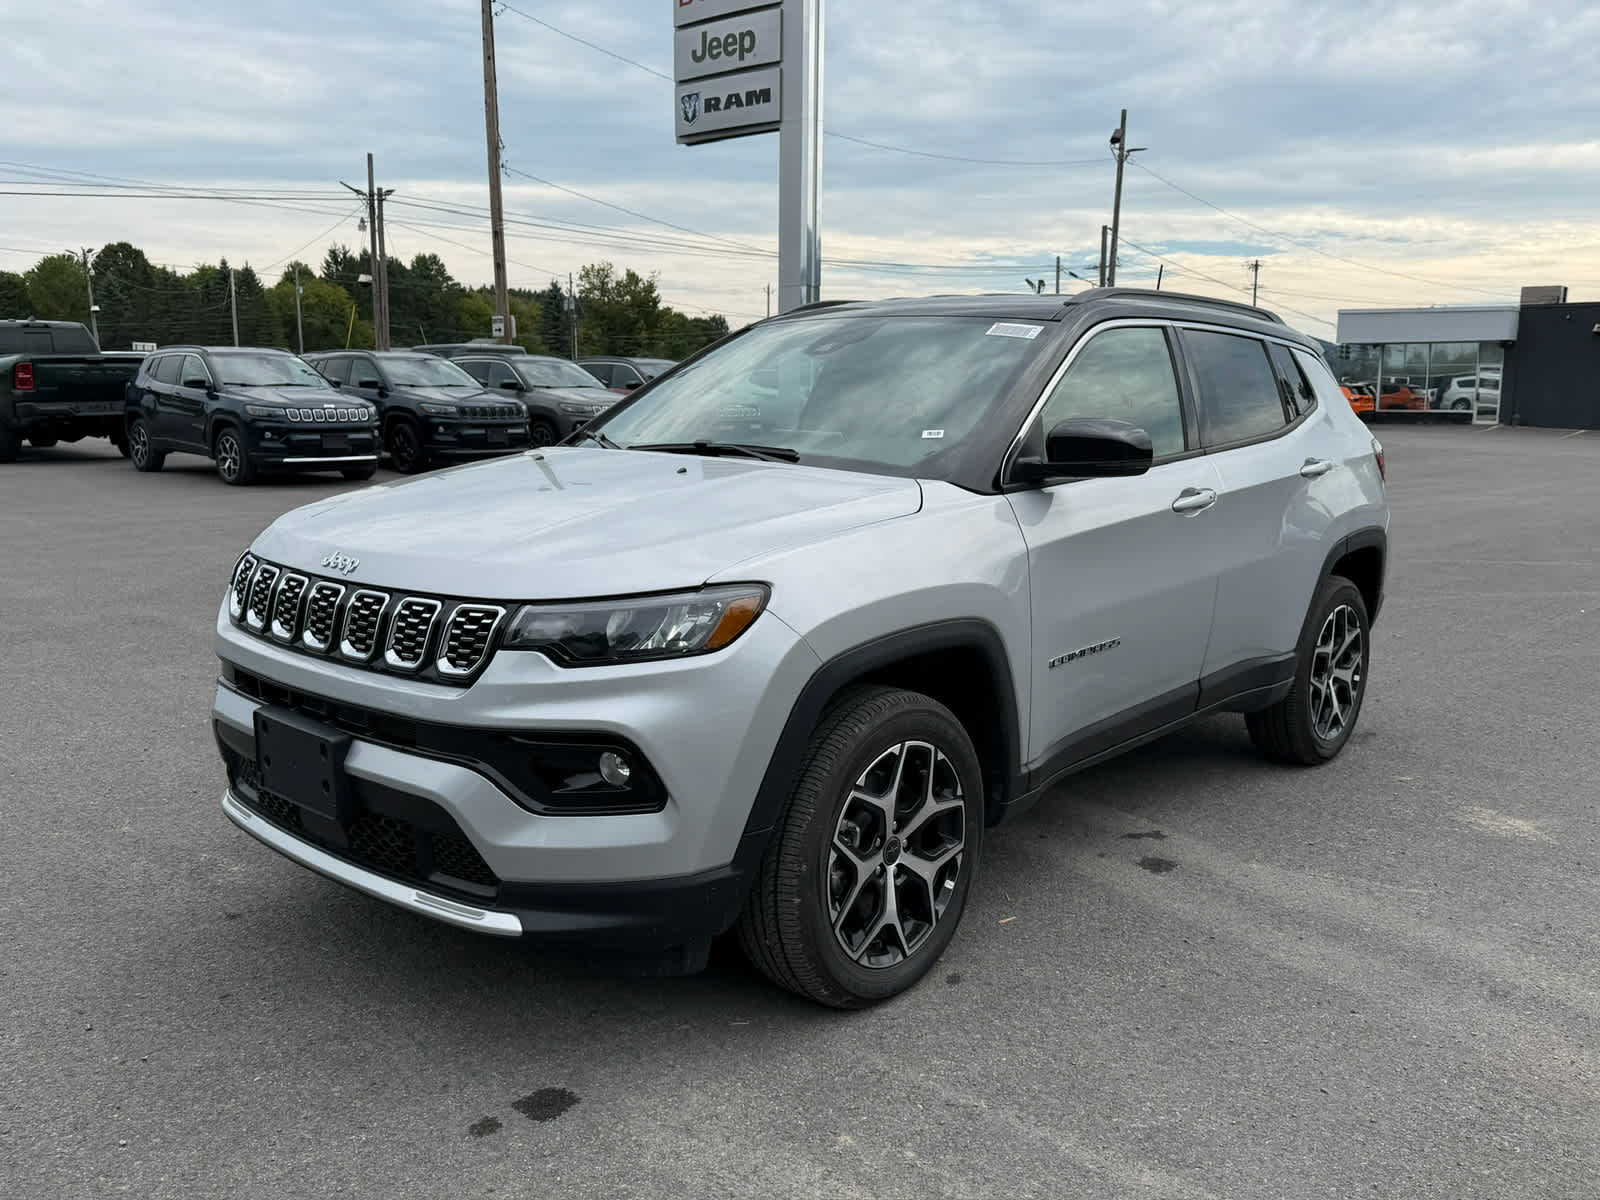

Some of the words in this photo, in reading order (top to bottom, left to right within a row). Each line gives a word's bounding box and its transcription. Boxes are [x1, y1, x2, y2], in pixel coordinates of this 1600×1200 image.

[691, 29, 756, 63] Jeep
[704, 87, 771, 113] RAM
[320, 551, 360, 576] Jeep
